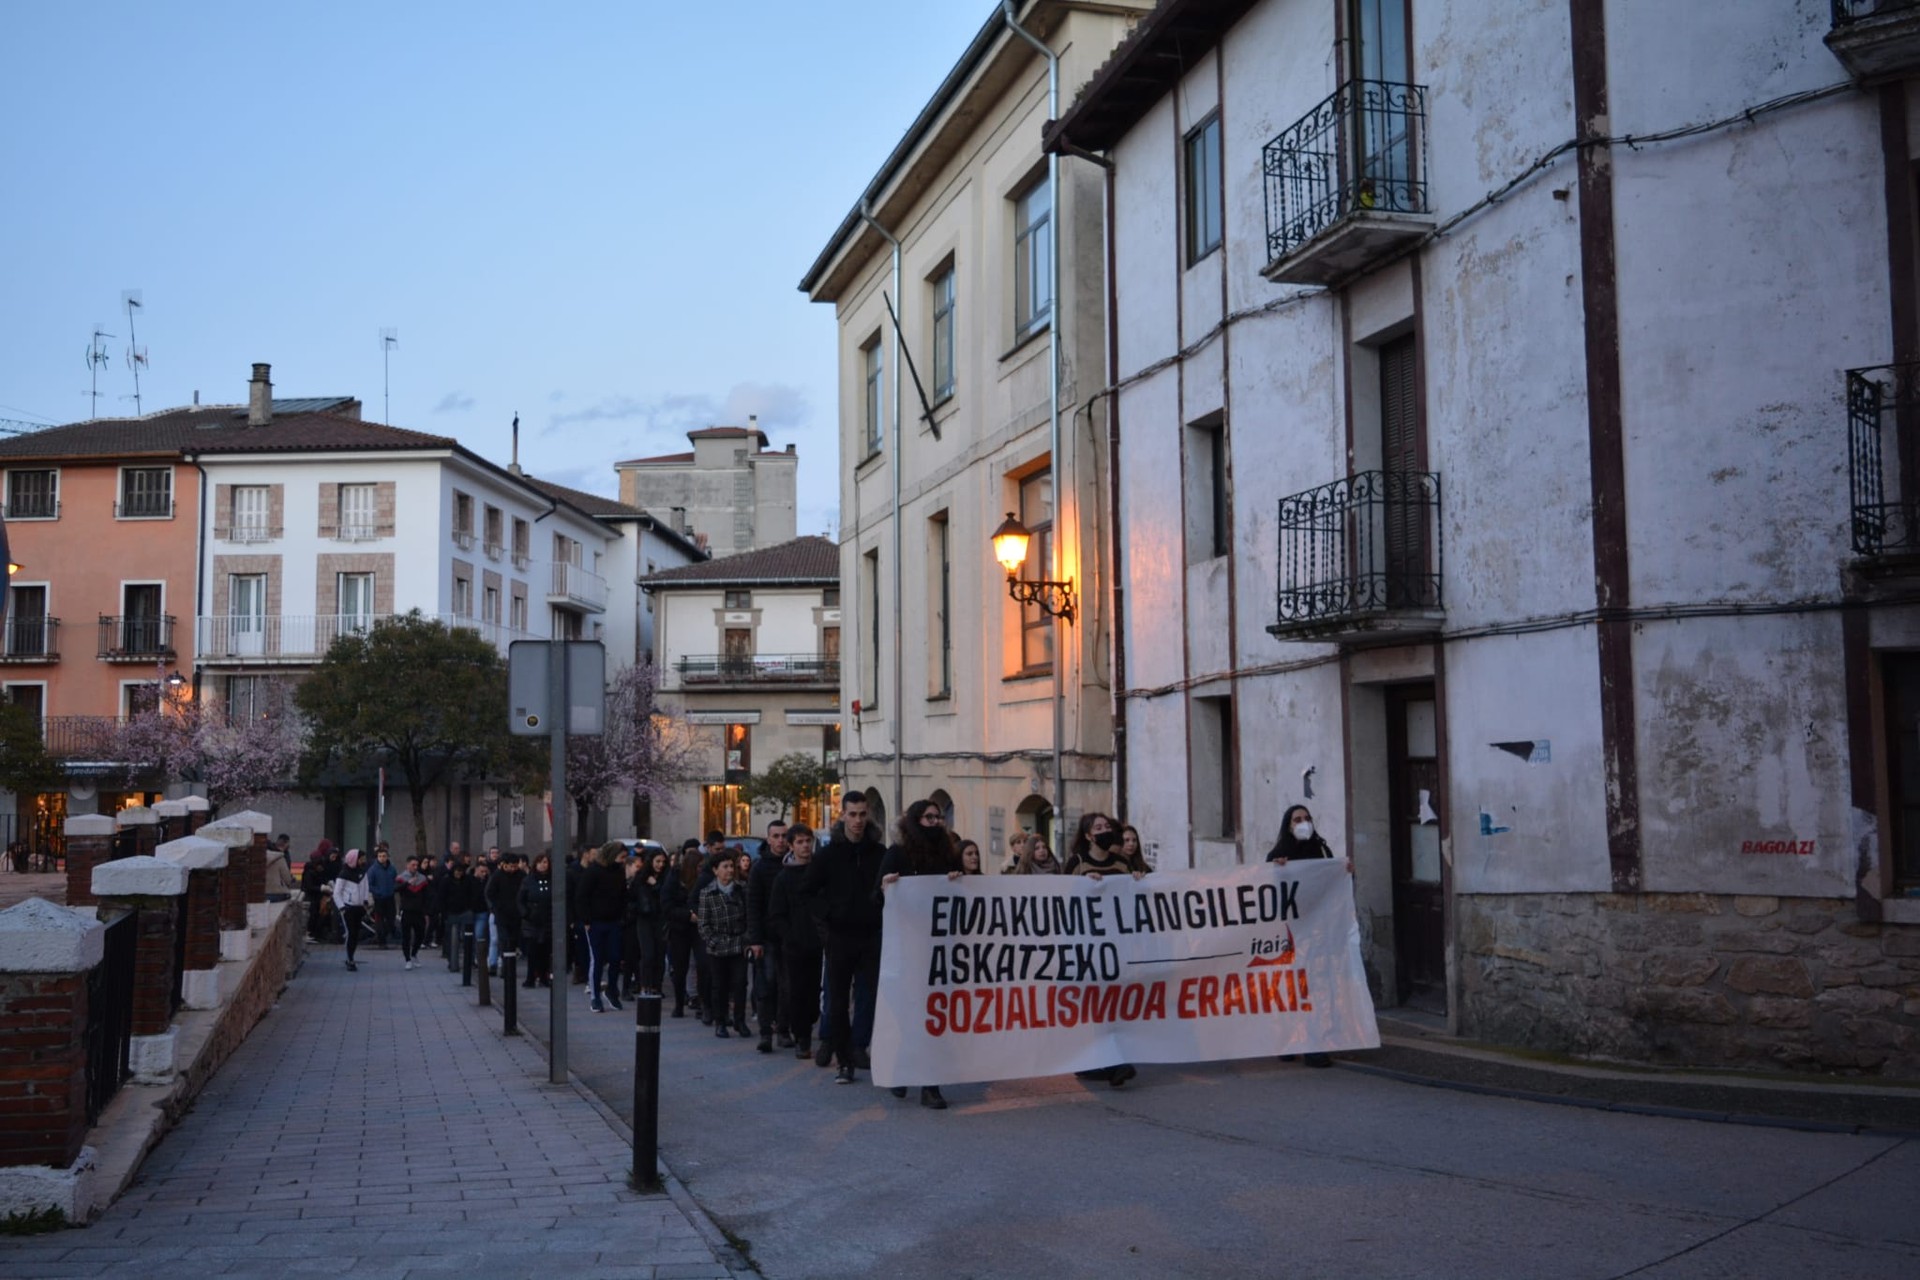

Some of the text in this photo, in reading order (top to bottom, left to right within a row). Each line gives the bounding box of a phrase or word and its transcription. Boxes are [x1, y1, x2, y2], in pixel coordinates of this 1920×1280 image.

[1742, 839, 1816, 855] BAGOAZI
[931, 881, 1300, 937] EMAKUME LANGILEOK
[928, 942, 1120, 986] ASKATZEKO
[1251, 934, 1293, 956] itaia
[925, 968, 1312, 1037] SOZIALISMOA ERAIKI!
